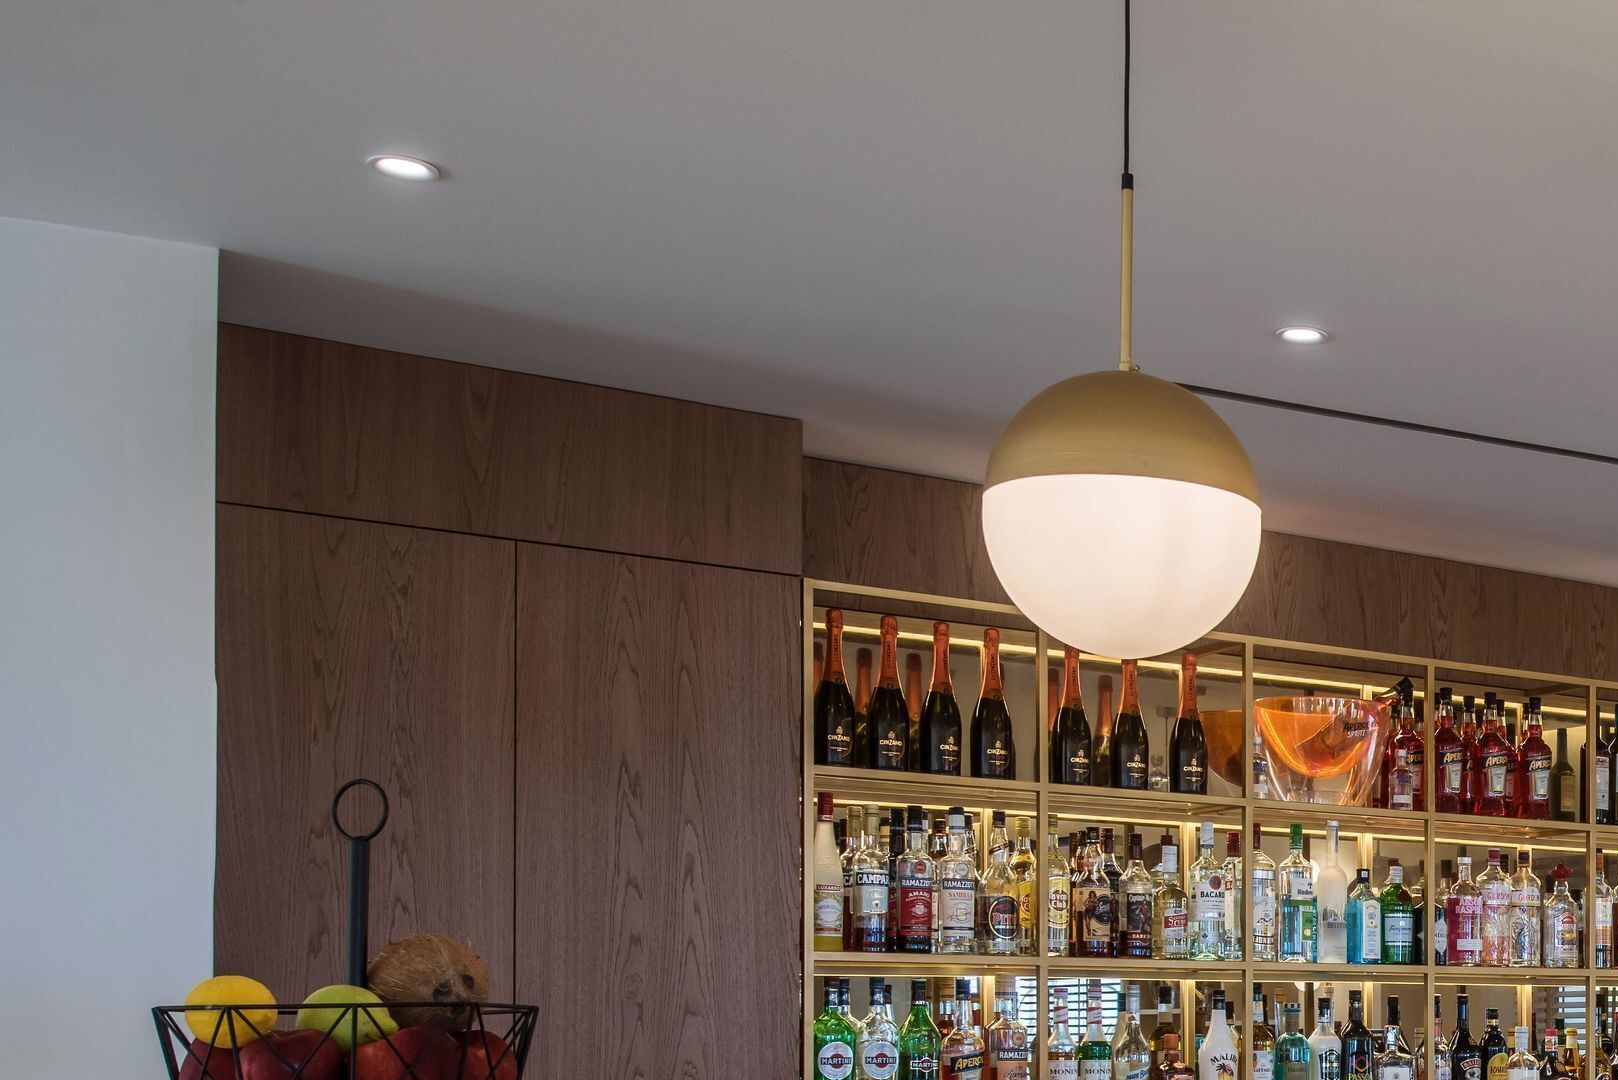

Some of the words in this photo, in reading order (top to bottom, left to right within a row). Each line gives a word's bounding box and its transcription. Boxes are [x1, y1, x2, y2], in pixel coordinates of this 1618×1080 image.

[827, 734, 851, 742] CINZANO
[879, 739, 903, 747] CINZANO
[1485, 756, 1507, 767] APERO
[1528, 760, 1551, 771] APERO
[821, 1057, 851, 1065] MARTINI
